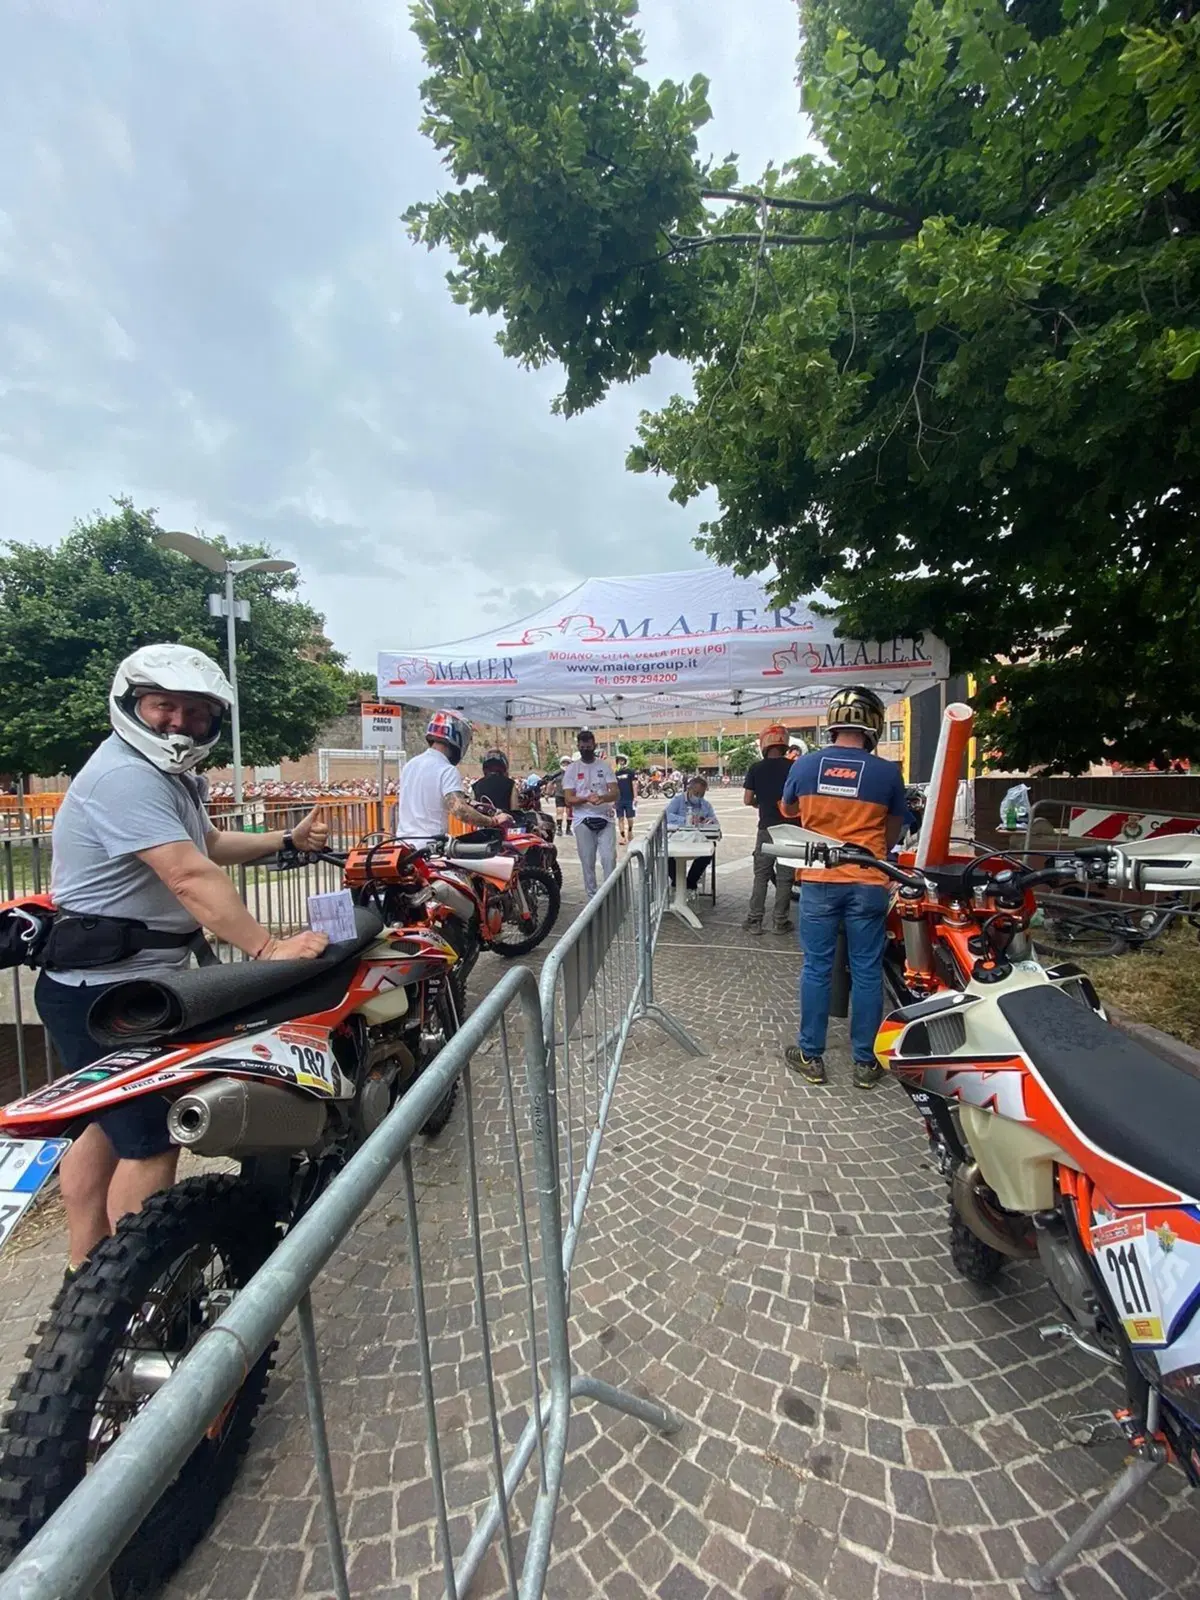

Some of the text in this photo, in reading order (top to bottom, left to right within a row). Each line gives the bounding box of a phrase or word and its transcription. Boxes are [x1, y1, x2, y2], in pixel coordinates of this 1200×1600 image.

[669, 645, 700, 657] PIEVE
[703, 643, 727, 656] (PG)
[566, 658, 698, 673] www.maiergroup.it
[594, 673, 678, 685] Tel. 0578 294200
[824, 767, 858, 779] KTM
[289, 1044, 329, 1083] 282
[1105, 1242, 1151, 1315] 211
